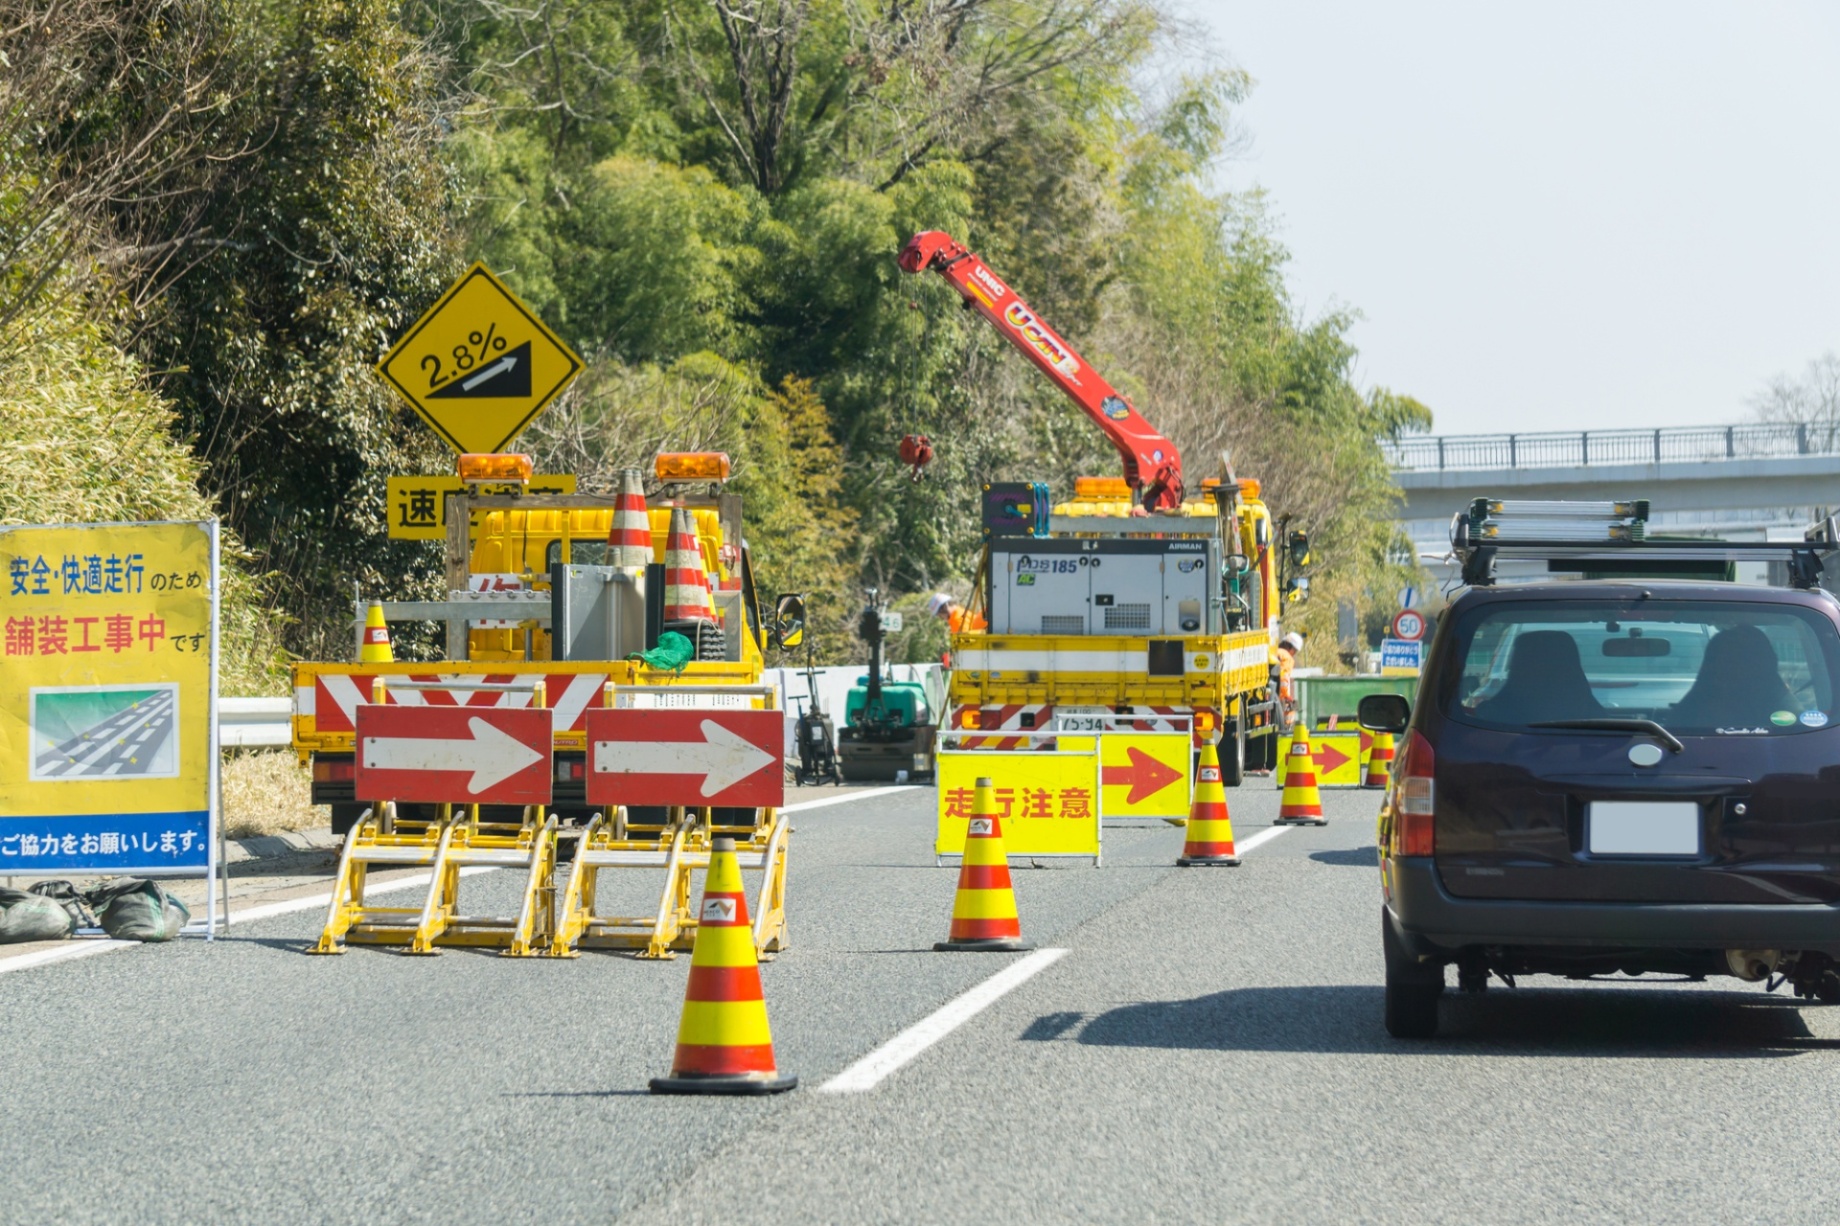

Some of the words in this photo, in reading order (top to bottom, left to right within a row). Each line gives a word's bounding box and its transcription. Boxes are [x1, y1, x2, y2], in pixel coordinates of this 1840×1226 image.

[975, 265, 1005, 297] UNIC
[421, 322, 507, 387] 2.8%
[1169, 543, 1203, 551] AIRMAN
[1399, 618, 1418, 633] 50
[945, 786, 1093, 819] 走行注意
[1, 829, 206, 858] ご協力をお願いします。
